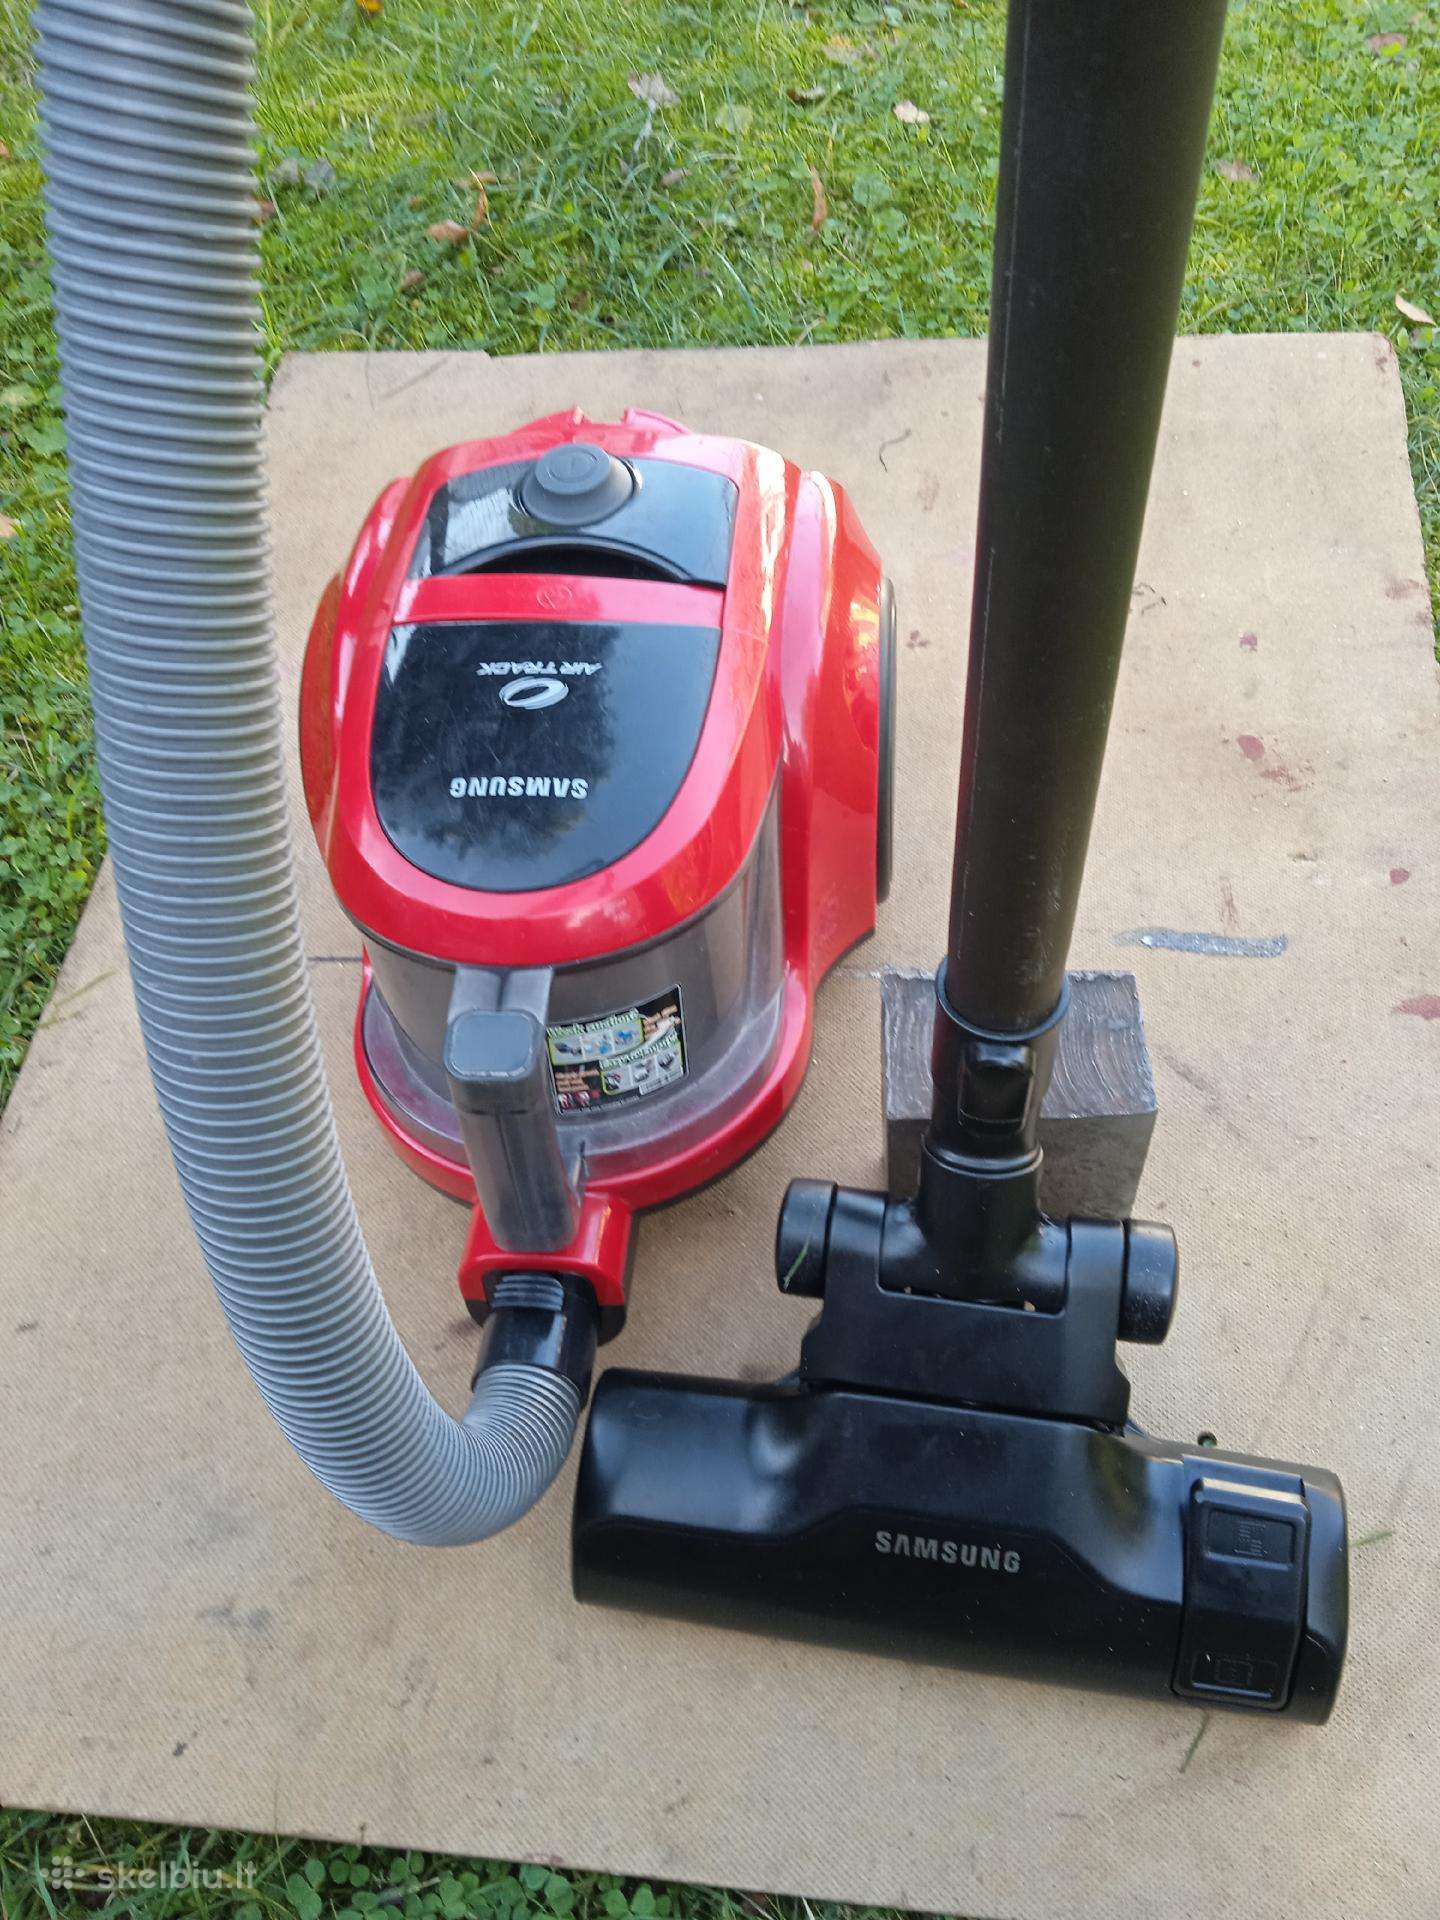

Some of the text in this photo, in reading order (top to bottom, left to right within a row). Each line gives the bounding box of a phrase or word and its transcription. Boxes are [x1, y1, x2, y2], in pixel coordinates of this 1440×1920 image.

[475, 661, 603, 676] AIR TRACK
[449, 776, 588, 799] SAMSUNG
[875, 1530, 1021, 1574] SAMSUNG
